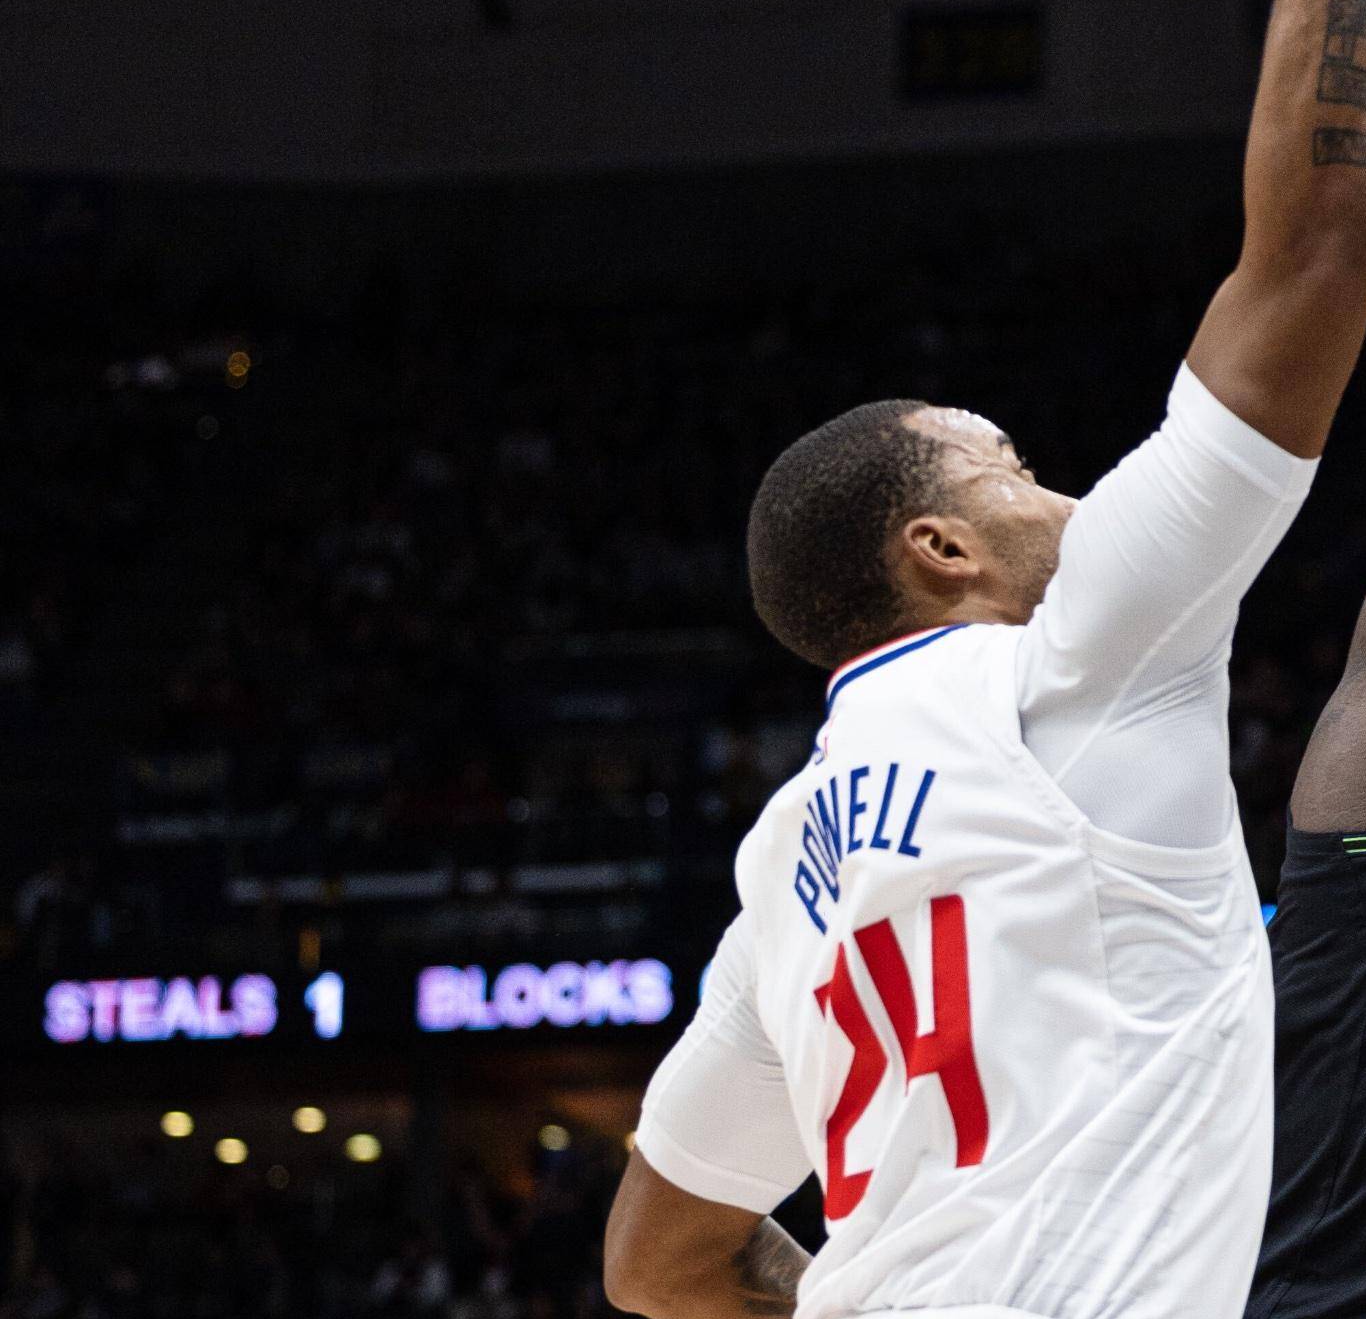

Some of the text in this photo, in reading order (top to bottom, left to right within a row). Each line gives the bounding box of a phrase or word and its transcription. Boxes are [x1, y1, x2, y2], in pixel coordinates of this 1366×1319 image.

[794, 763, 936, 935] POWELL
[44, 959, 673, 1042] STEALS 1 BLOCKS
[812, 894, 990, 1221] 24
